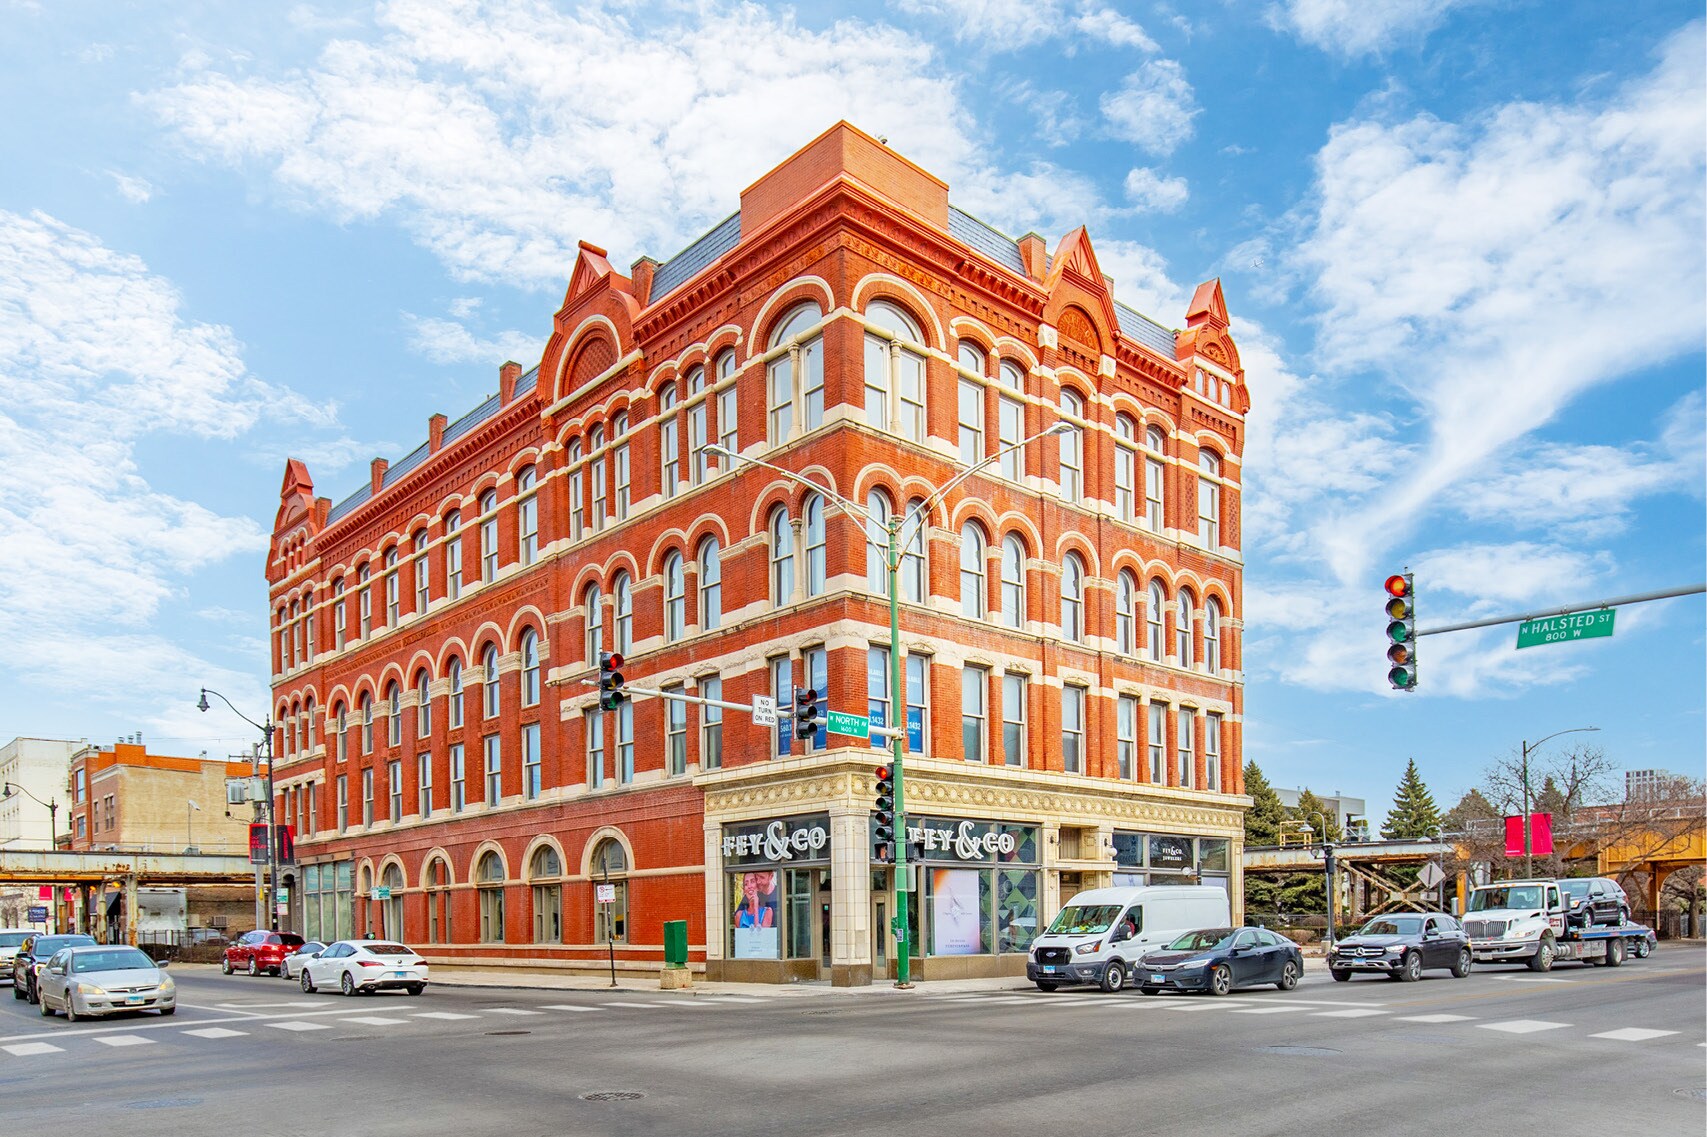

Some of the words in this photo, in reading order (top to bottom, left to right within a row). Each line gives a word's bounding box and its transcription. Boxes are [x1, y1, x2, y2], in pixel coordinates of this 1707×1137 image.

[1532, 615, 1594, 634] HALSTED
[1599, 614, 1610, 622] ST
[1546, 632, 1566, 641] 800
[758, 707, 772, 715] TURN
[835, 715, 860, 726] NORTH
